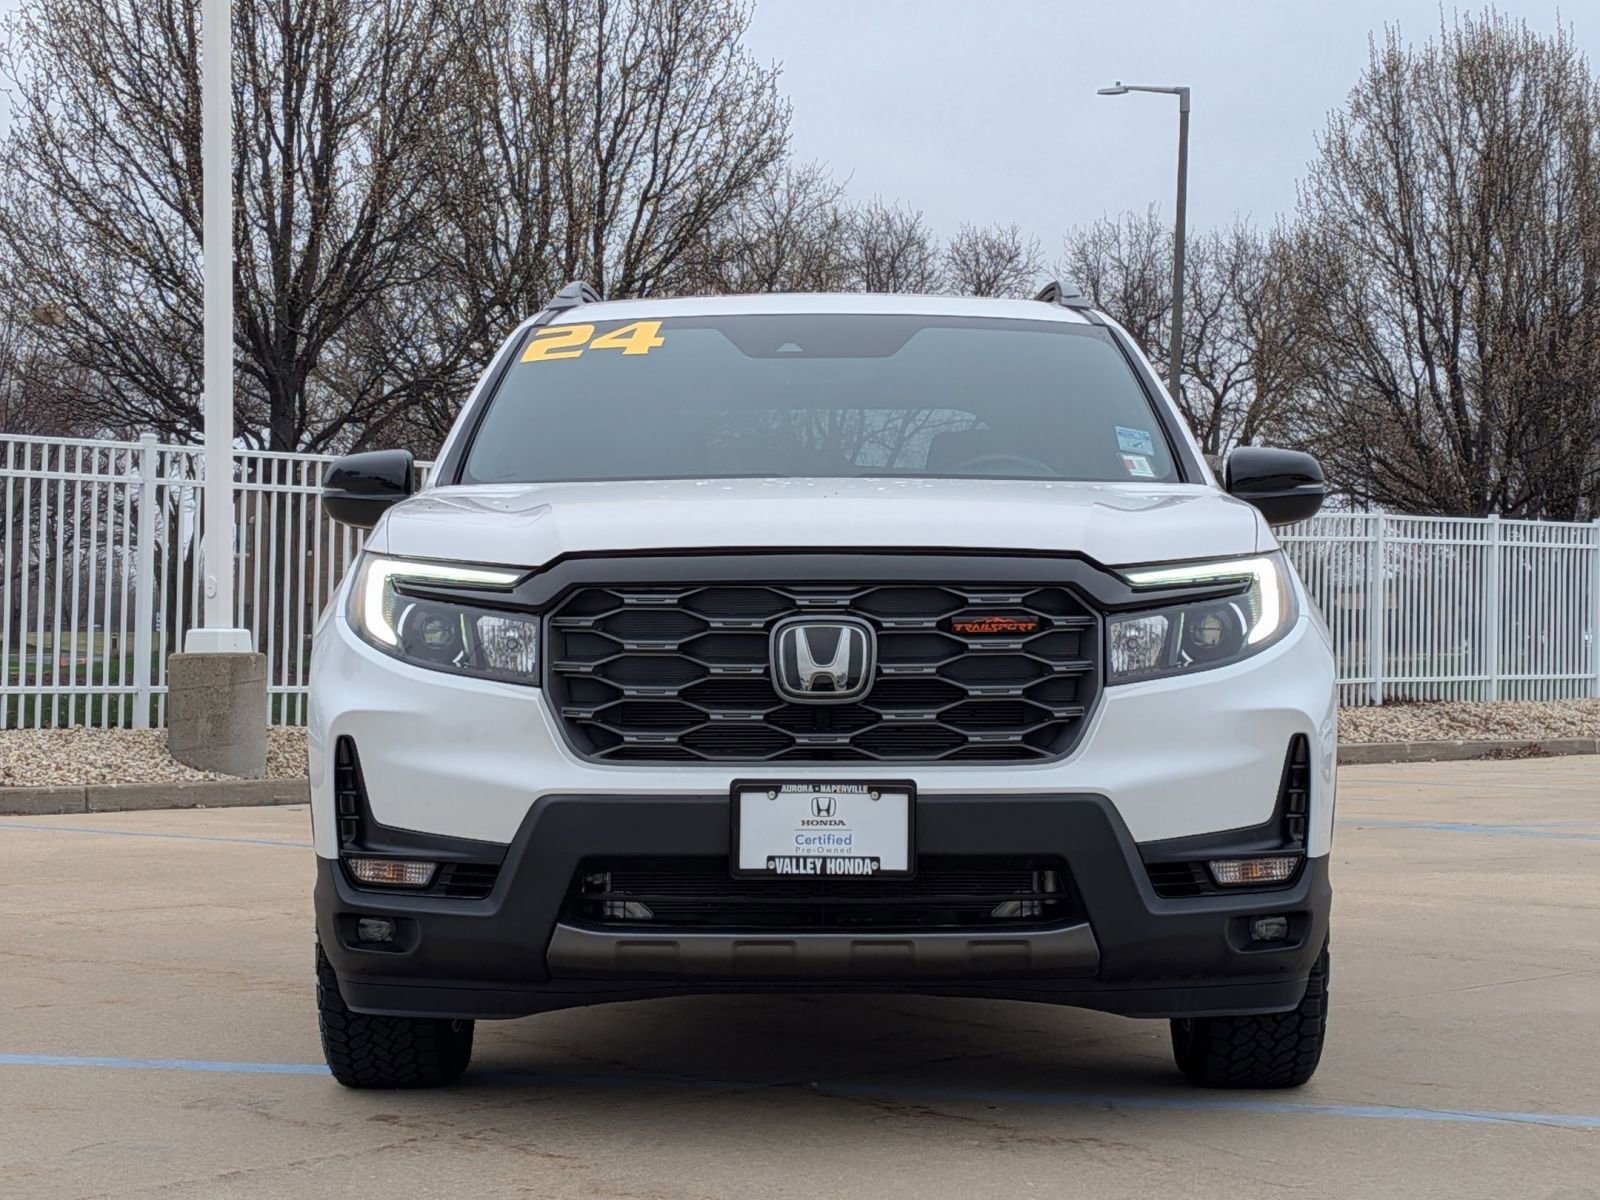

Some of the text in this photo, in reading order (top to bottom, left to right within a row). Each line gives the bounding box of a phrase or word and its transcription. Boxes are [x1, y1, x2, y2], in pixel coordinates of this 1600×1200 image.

[520, 321, 665, 363] 24
[781, 785, 869, 794] AURORA NAPERVILLE
[795, 834, 852, 846] Certified
[775, 857, 873, 875] VALLEY HONDA
